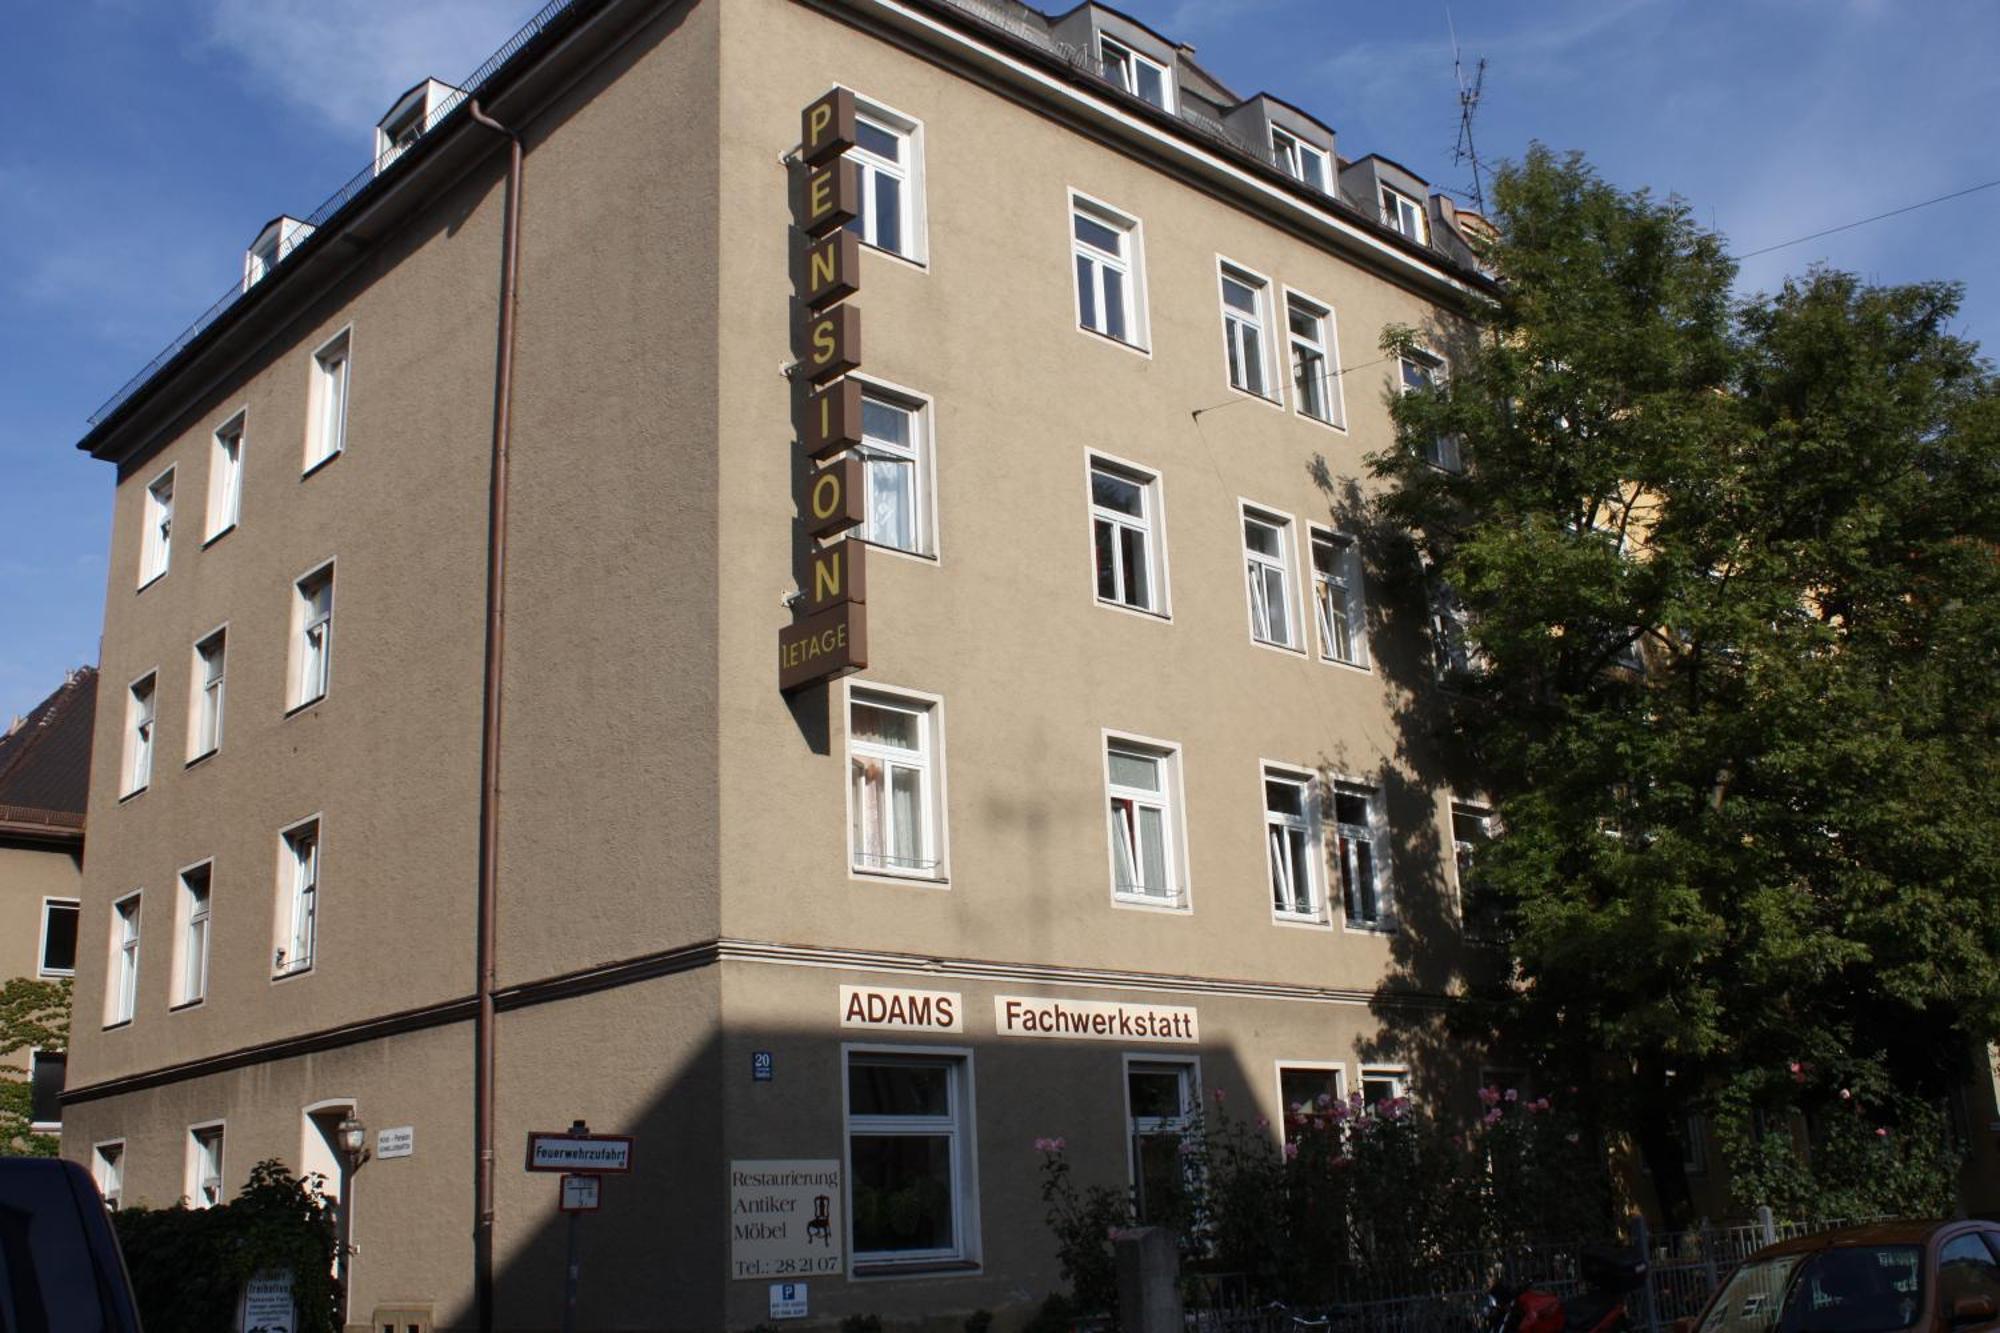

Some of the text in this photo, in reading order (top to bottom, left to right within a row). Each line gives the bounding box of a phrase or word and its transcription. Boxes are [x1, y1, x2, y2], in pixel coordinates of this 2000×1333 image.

[810, 103, 840, 603] PENSION
[846, 992, 955, 1028] ADAMS
[1006, 1001, 1193, 1038] Fachwerkstatt
[755, 1054, 770, 1067] 20
[536, 1145, 626, 1160] Feuerwehrzufahrt
[733, 1170, 839, 1188] Restaurierung
[734, 1196, 797, 1214] Antiker
[734, 1222, 787, 1241] Möbel
